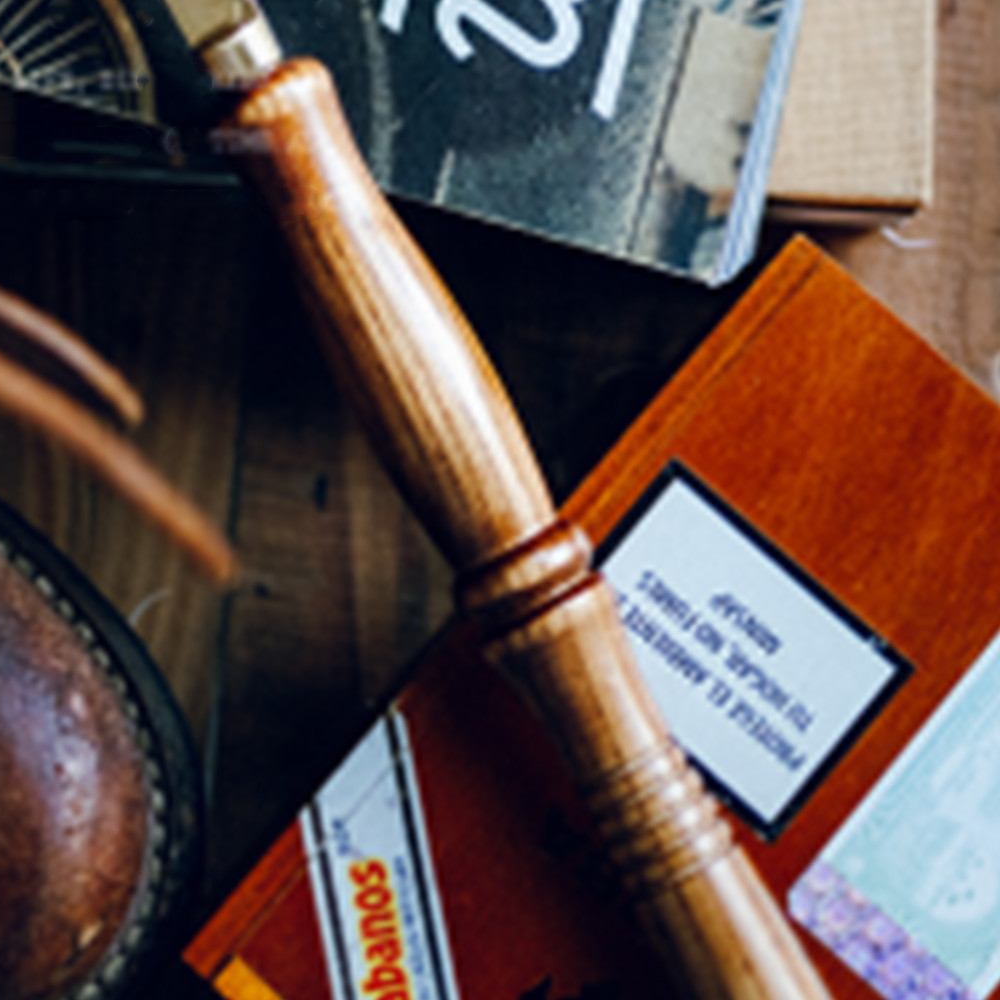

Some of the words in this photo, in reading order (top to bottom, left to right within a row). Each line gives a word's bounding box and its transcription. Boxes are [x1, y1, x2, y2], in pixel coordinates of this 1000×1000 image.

[698, 622, 726, 655] NO
[706, 678, 734, 710] EL
[787, 700, 814, 735] TU
